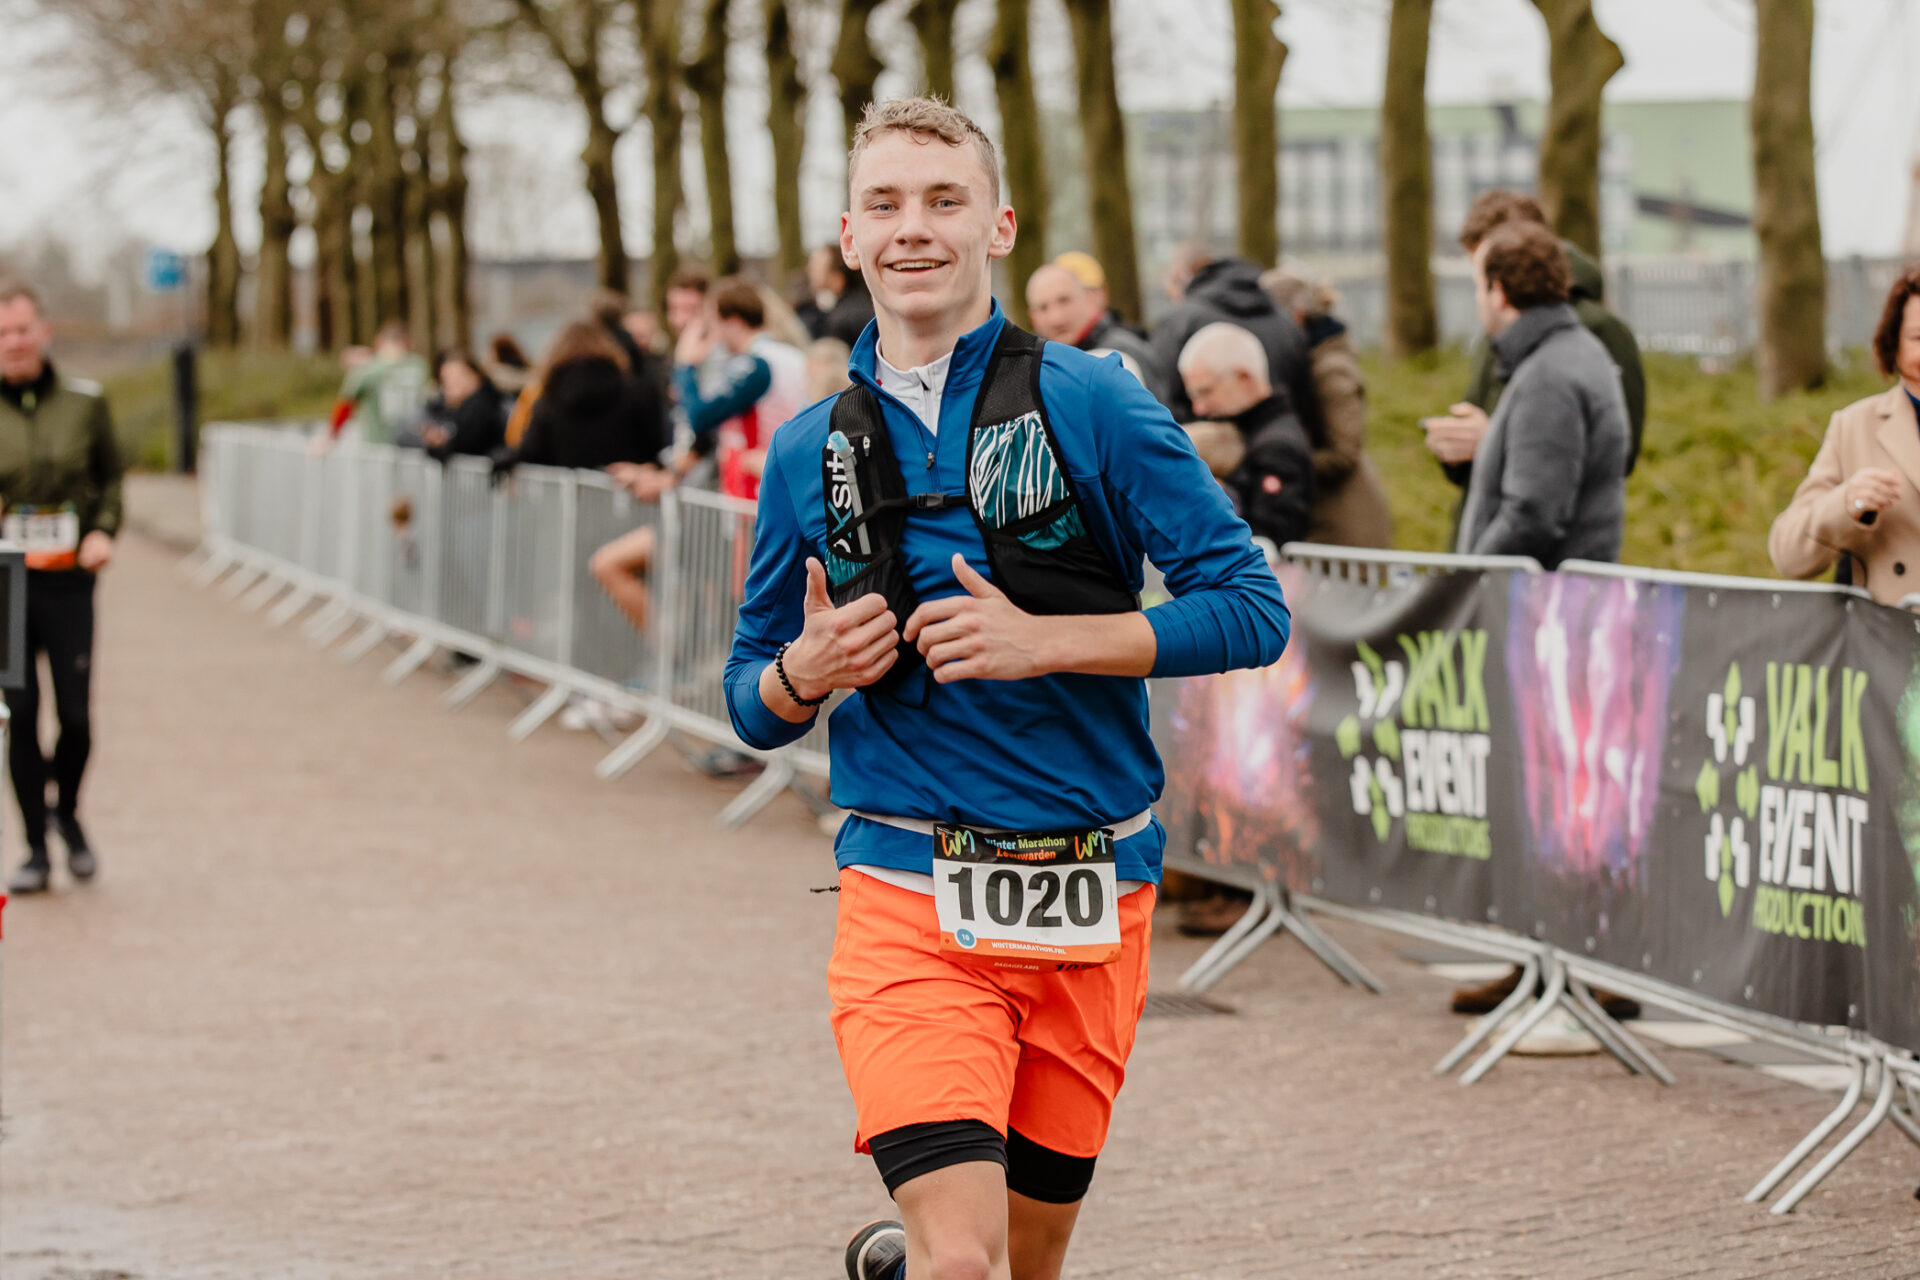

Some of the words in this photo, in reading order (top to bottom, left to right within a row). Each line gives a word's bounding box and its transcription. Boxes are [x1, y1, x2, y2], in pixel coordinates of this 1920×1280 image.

[1397, 629, 1488, 731] VALK
[1766, 661, 1869, 793] VALK
[1401, 729, 1490, 818] EVENT
[1018, 836, 1066, 849] Marathon
[1760, 785, 1868, 896] EVENT
[948, 867, 1104, 927] 1020
